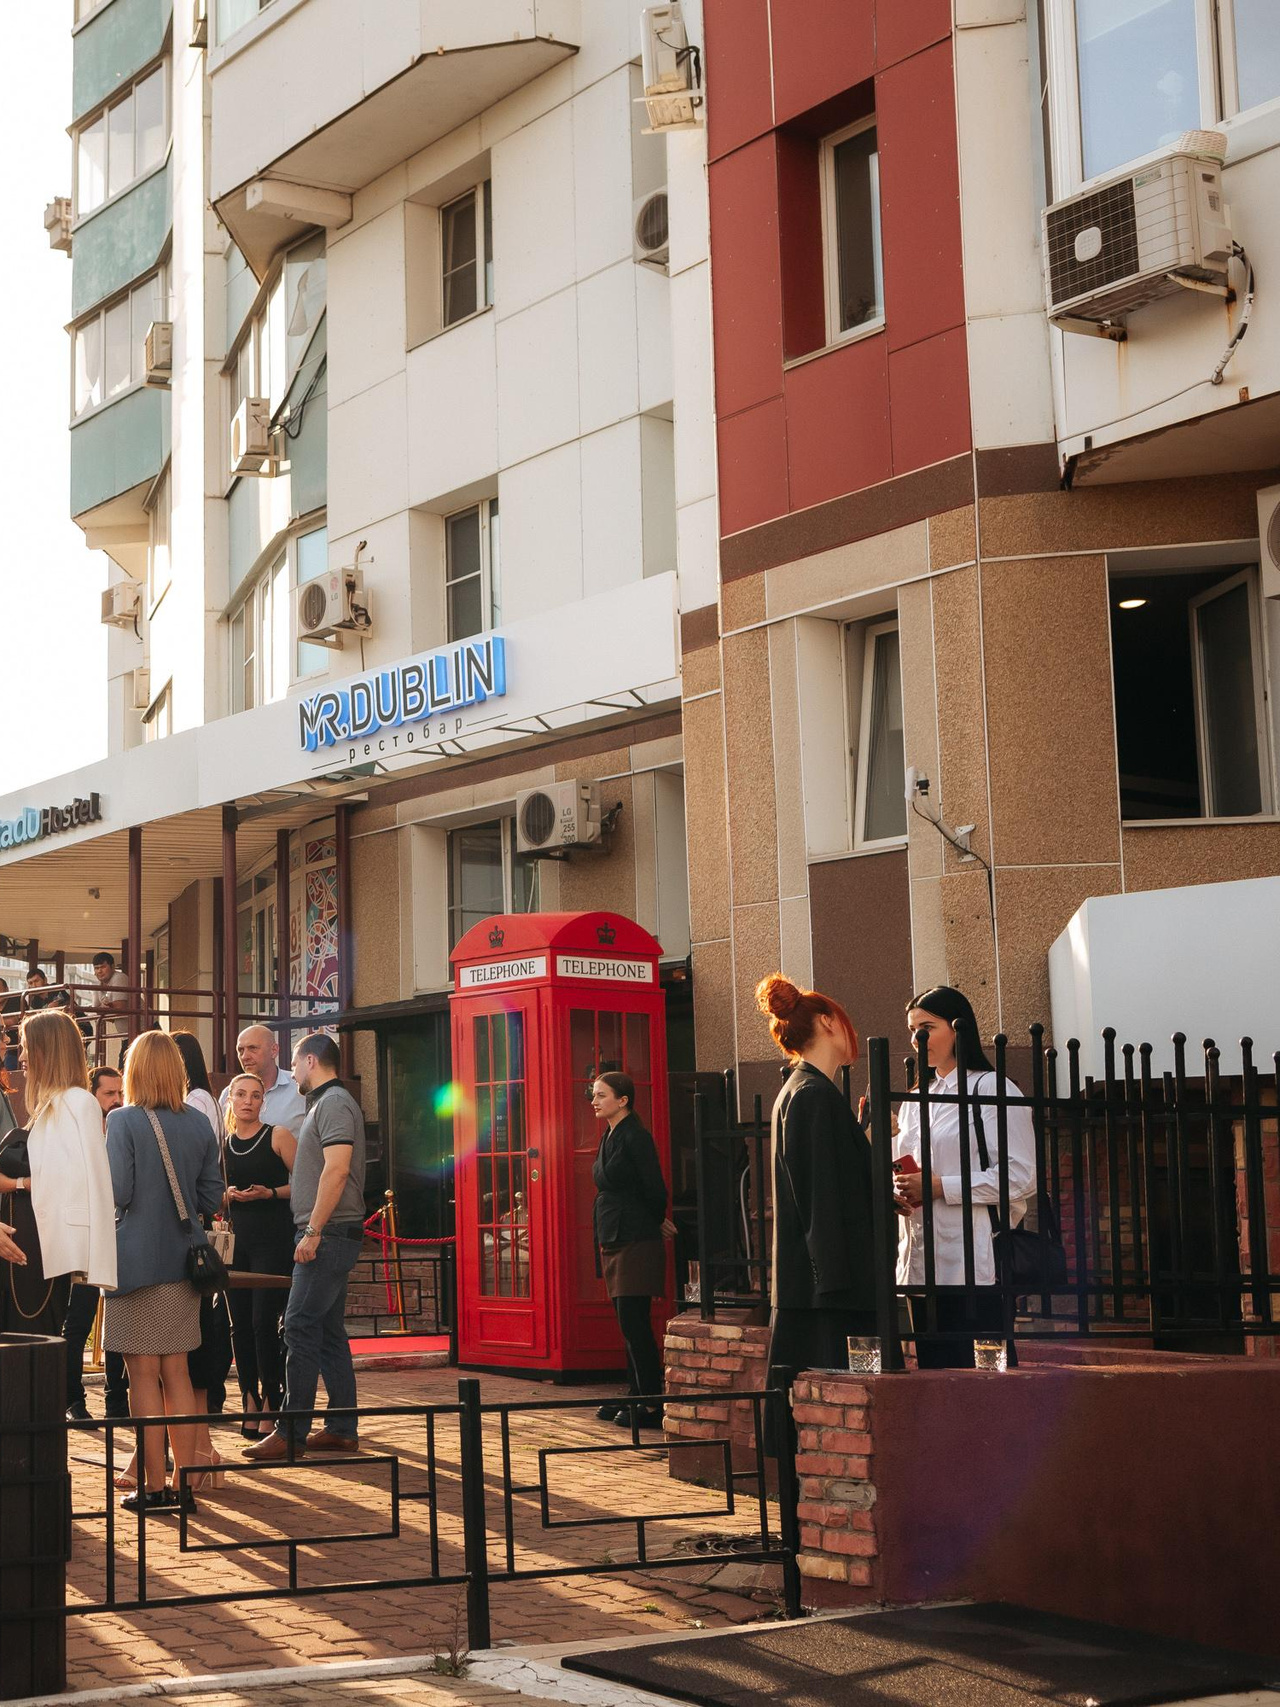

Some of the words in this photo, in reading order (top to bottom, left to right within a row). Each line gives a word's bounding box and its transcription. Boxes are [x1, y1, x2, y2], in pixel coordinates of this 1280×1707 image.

[349, 717, 463, 763] рестобар
[562, 807, 572, 816] LG
[563, 823, 575, 833] 255
[470, 960, 536, 983] TELEPHONE
[562, 959, 646, 979] TELEPHONE
